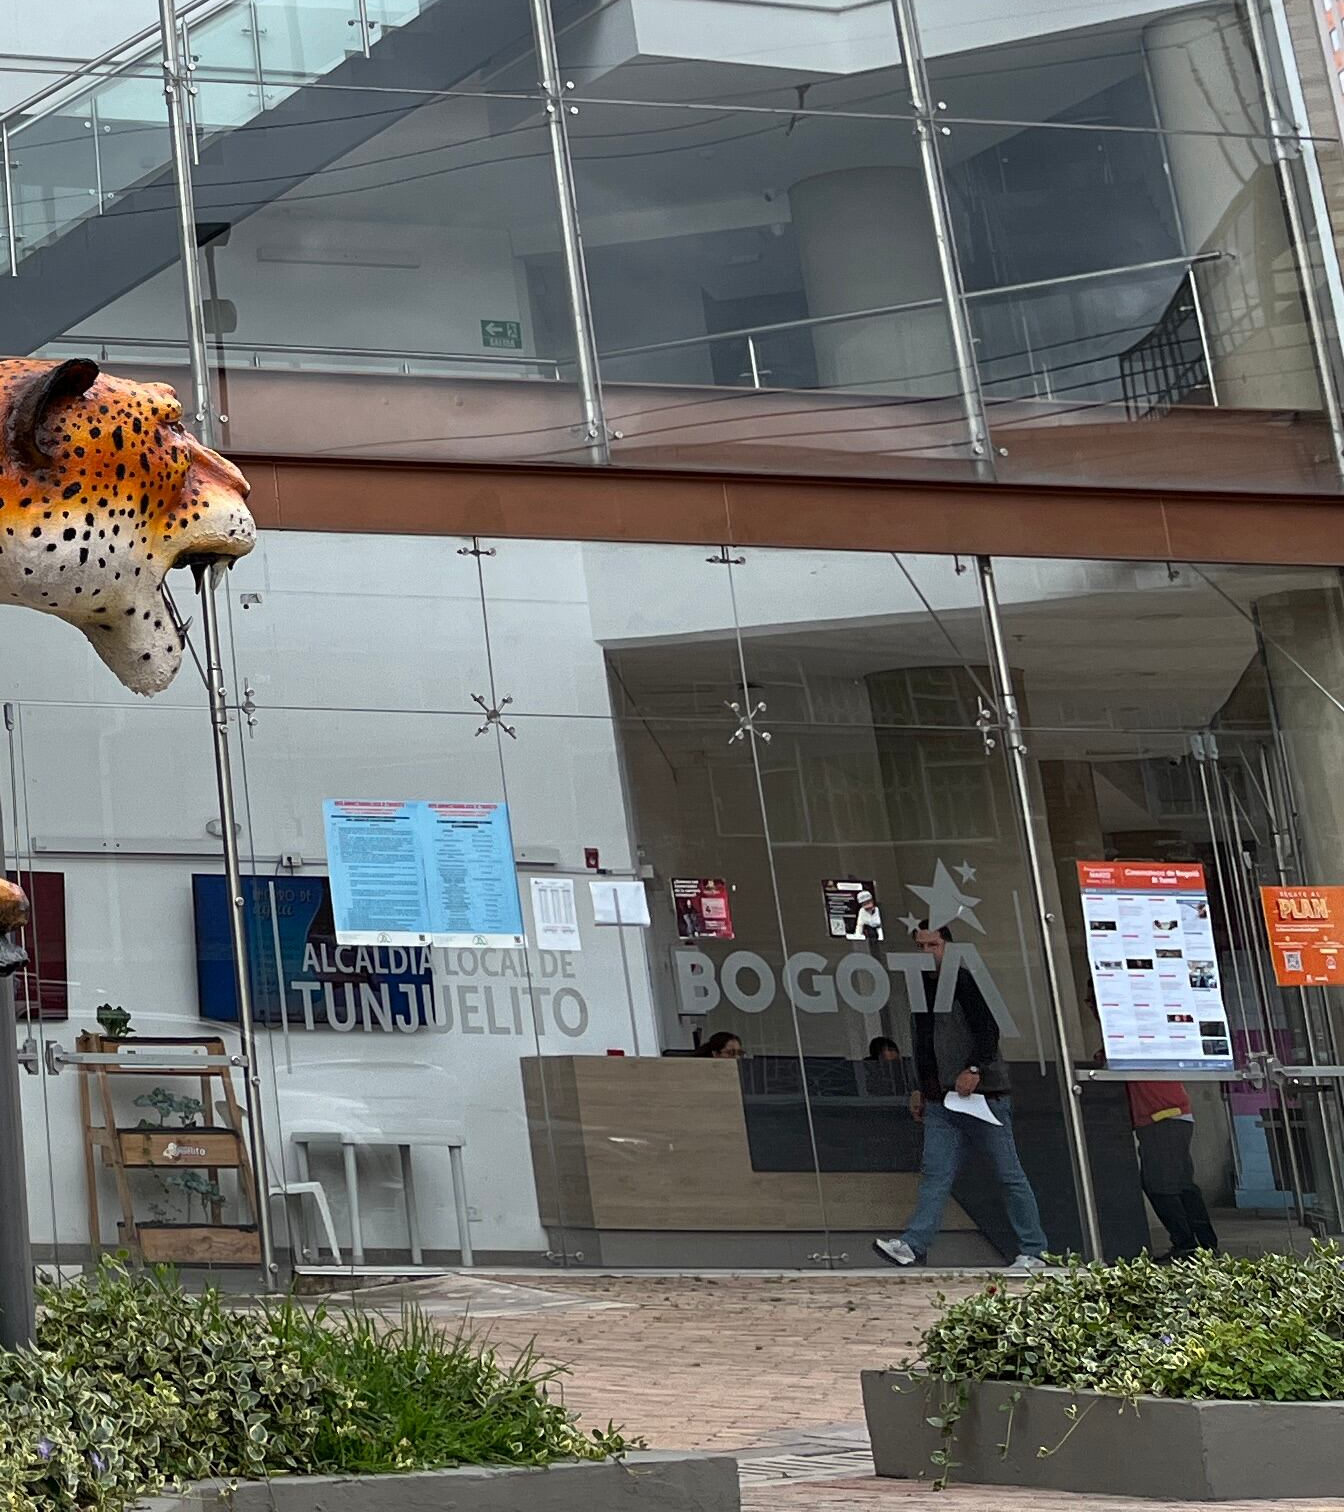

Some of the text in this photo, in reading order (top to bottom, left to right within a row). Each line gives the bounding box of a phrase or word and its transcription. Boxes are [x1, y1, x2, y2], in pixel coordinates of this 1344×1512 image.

[1277, 898, 1329, 919] PLAN
[444, 947, 533, 979] LOCAL
[541, 948, 576, 980] DE
[291, 980, 589, 1038] TUNJUELITO
